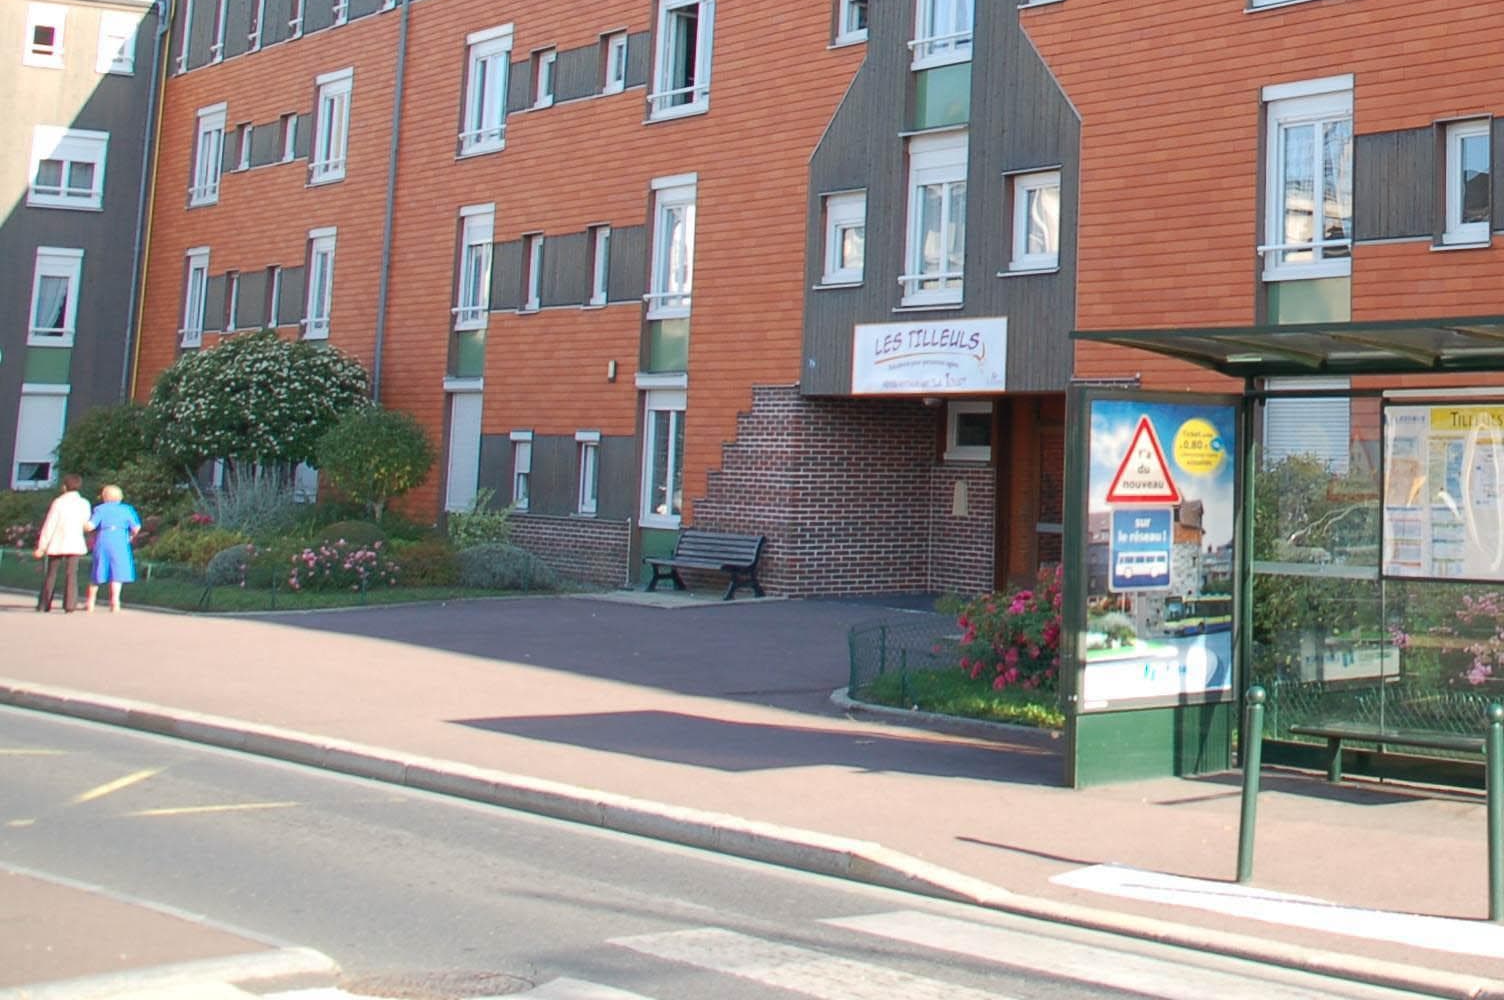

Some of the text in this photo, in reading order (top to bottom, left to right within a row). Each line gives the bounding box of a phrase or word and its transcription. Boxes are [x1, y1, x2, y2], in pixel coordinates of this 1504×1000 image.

[875, 328, 980, 355] LES TILLEULS
[1137, 463, 1151, 474] du
[1122, 480, 1164, 489] nouveau
[1134, 517, 1152, 529] sur
[1117, 529, 1128, 543] le
